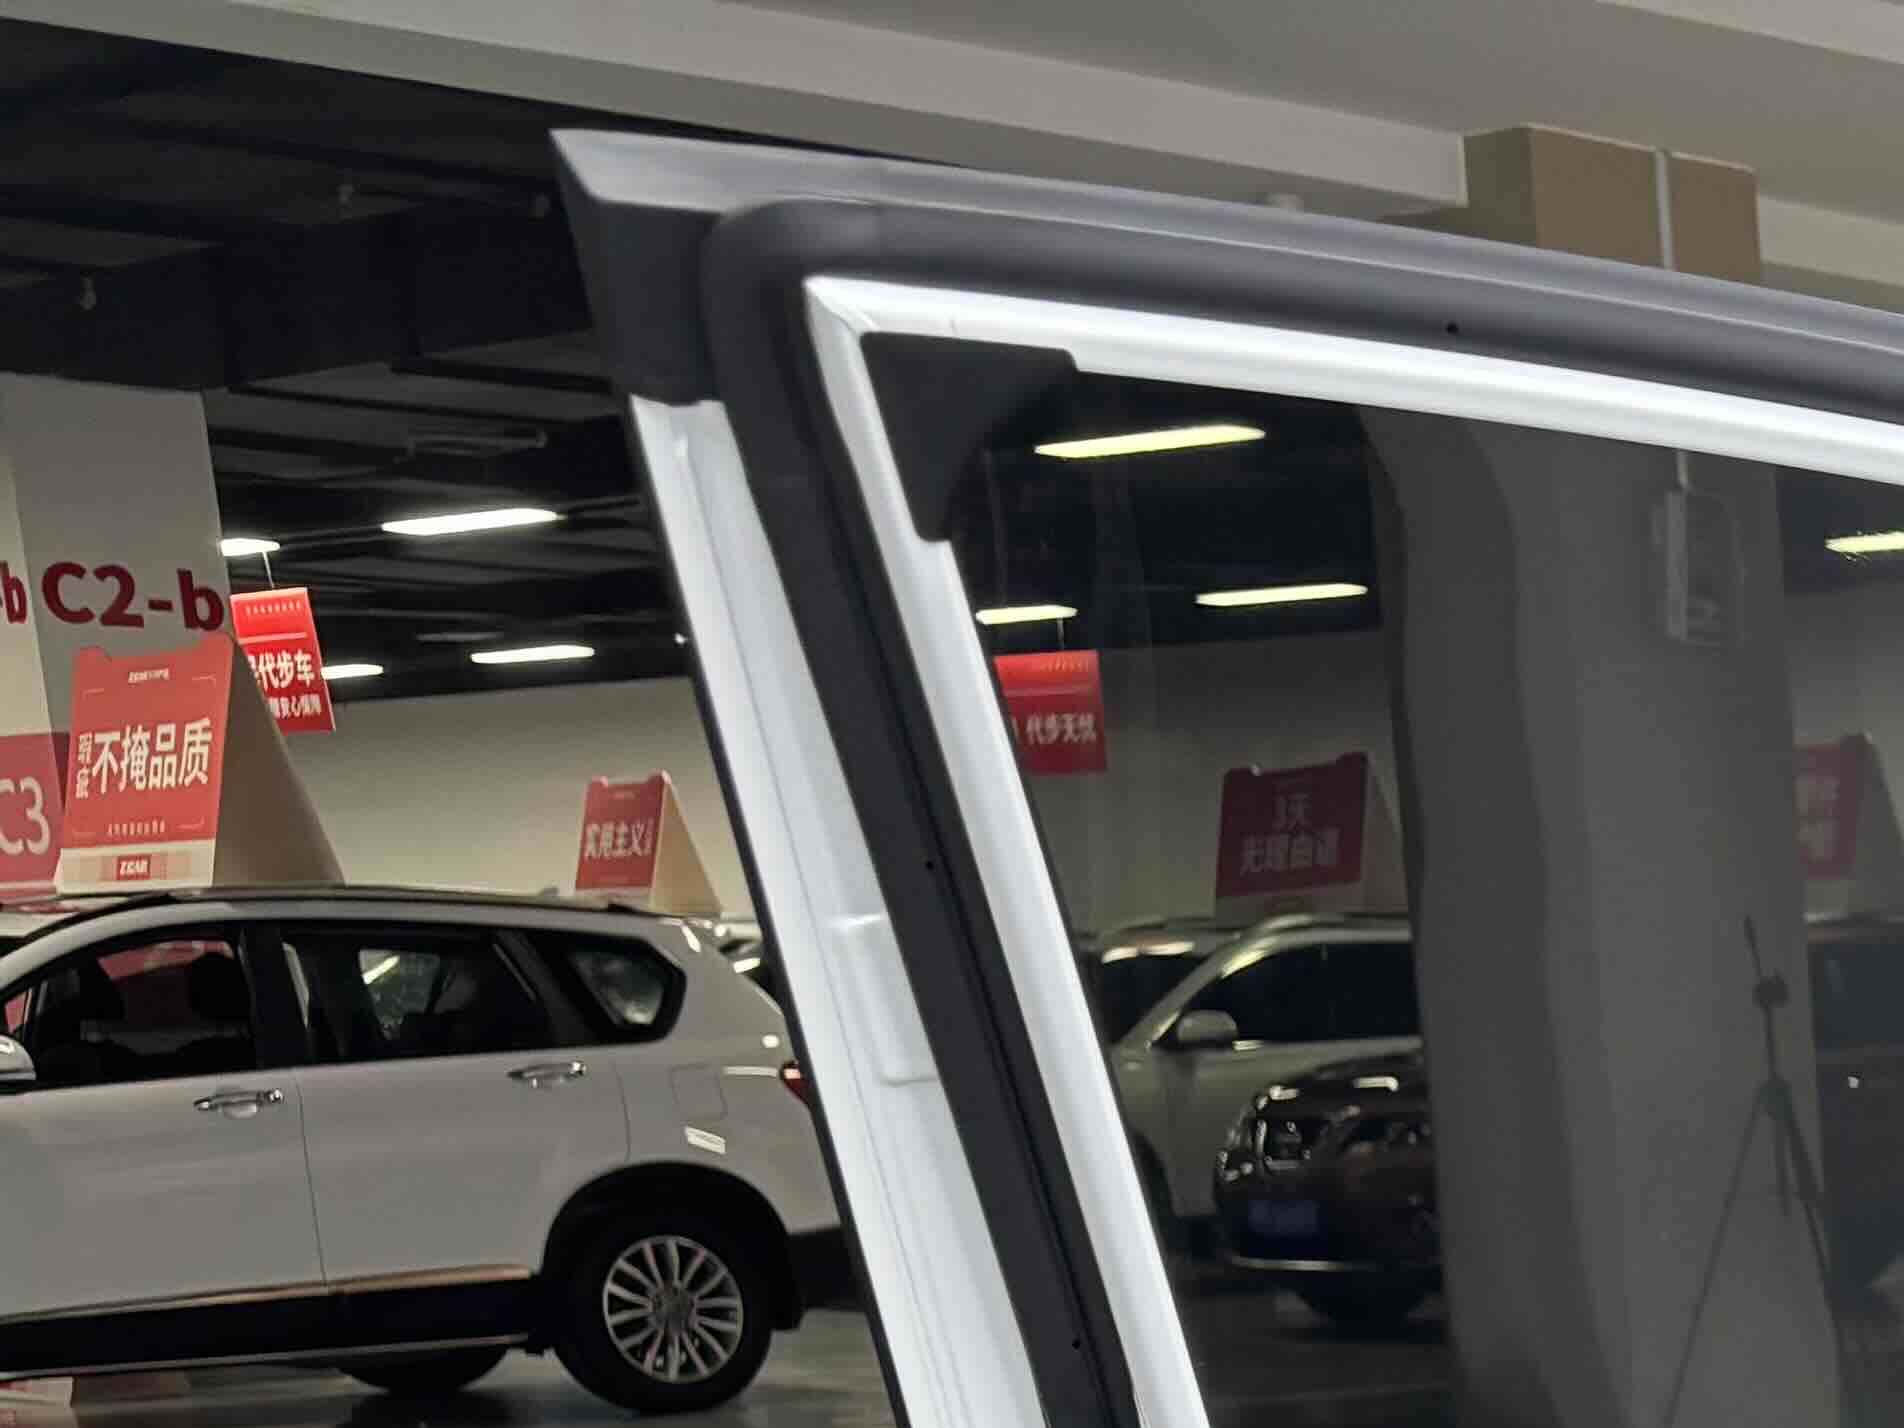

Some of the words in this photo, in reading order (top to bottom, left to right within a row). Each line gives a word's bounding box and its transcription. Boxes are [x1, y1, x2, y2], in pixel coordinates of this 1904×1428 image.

[41, 561, 225, 632] C2-b
[247, 649, 315, 692] 代步车
[91, 717, 213, 795] 不掩品质
